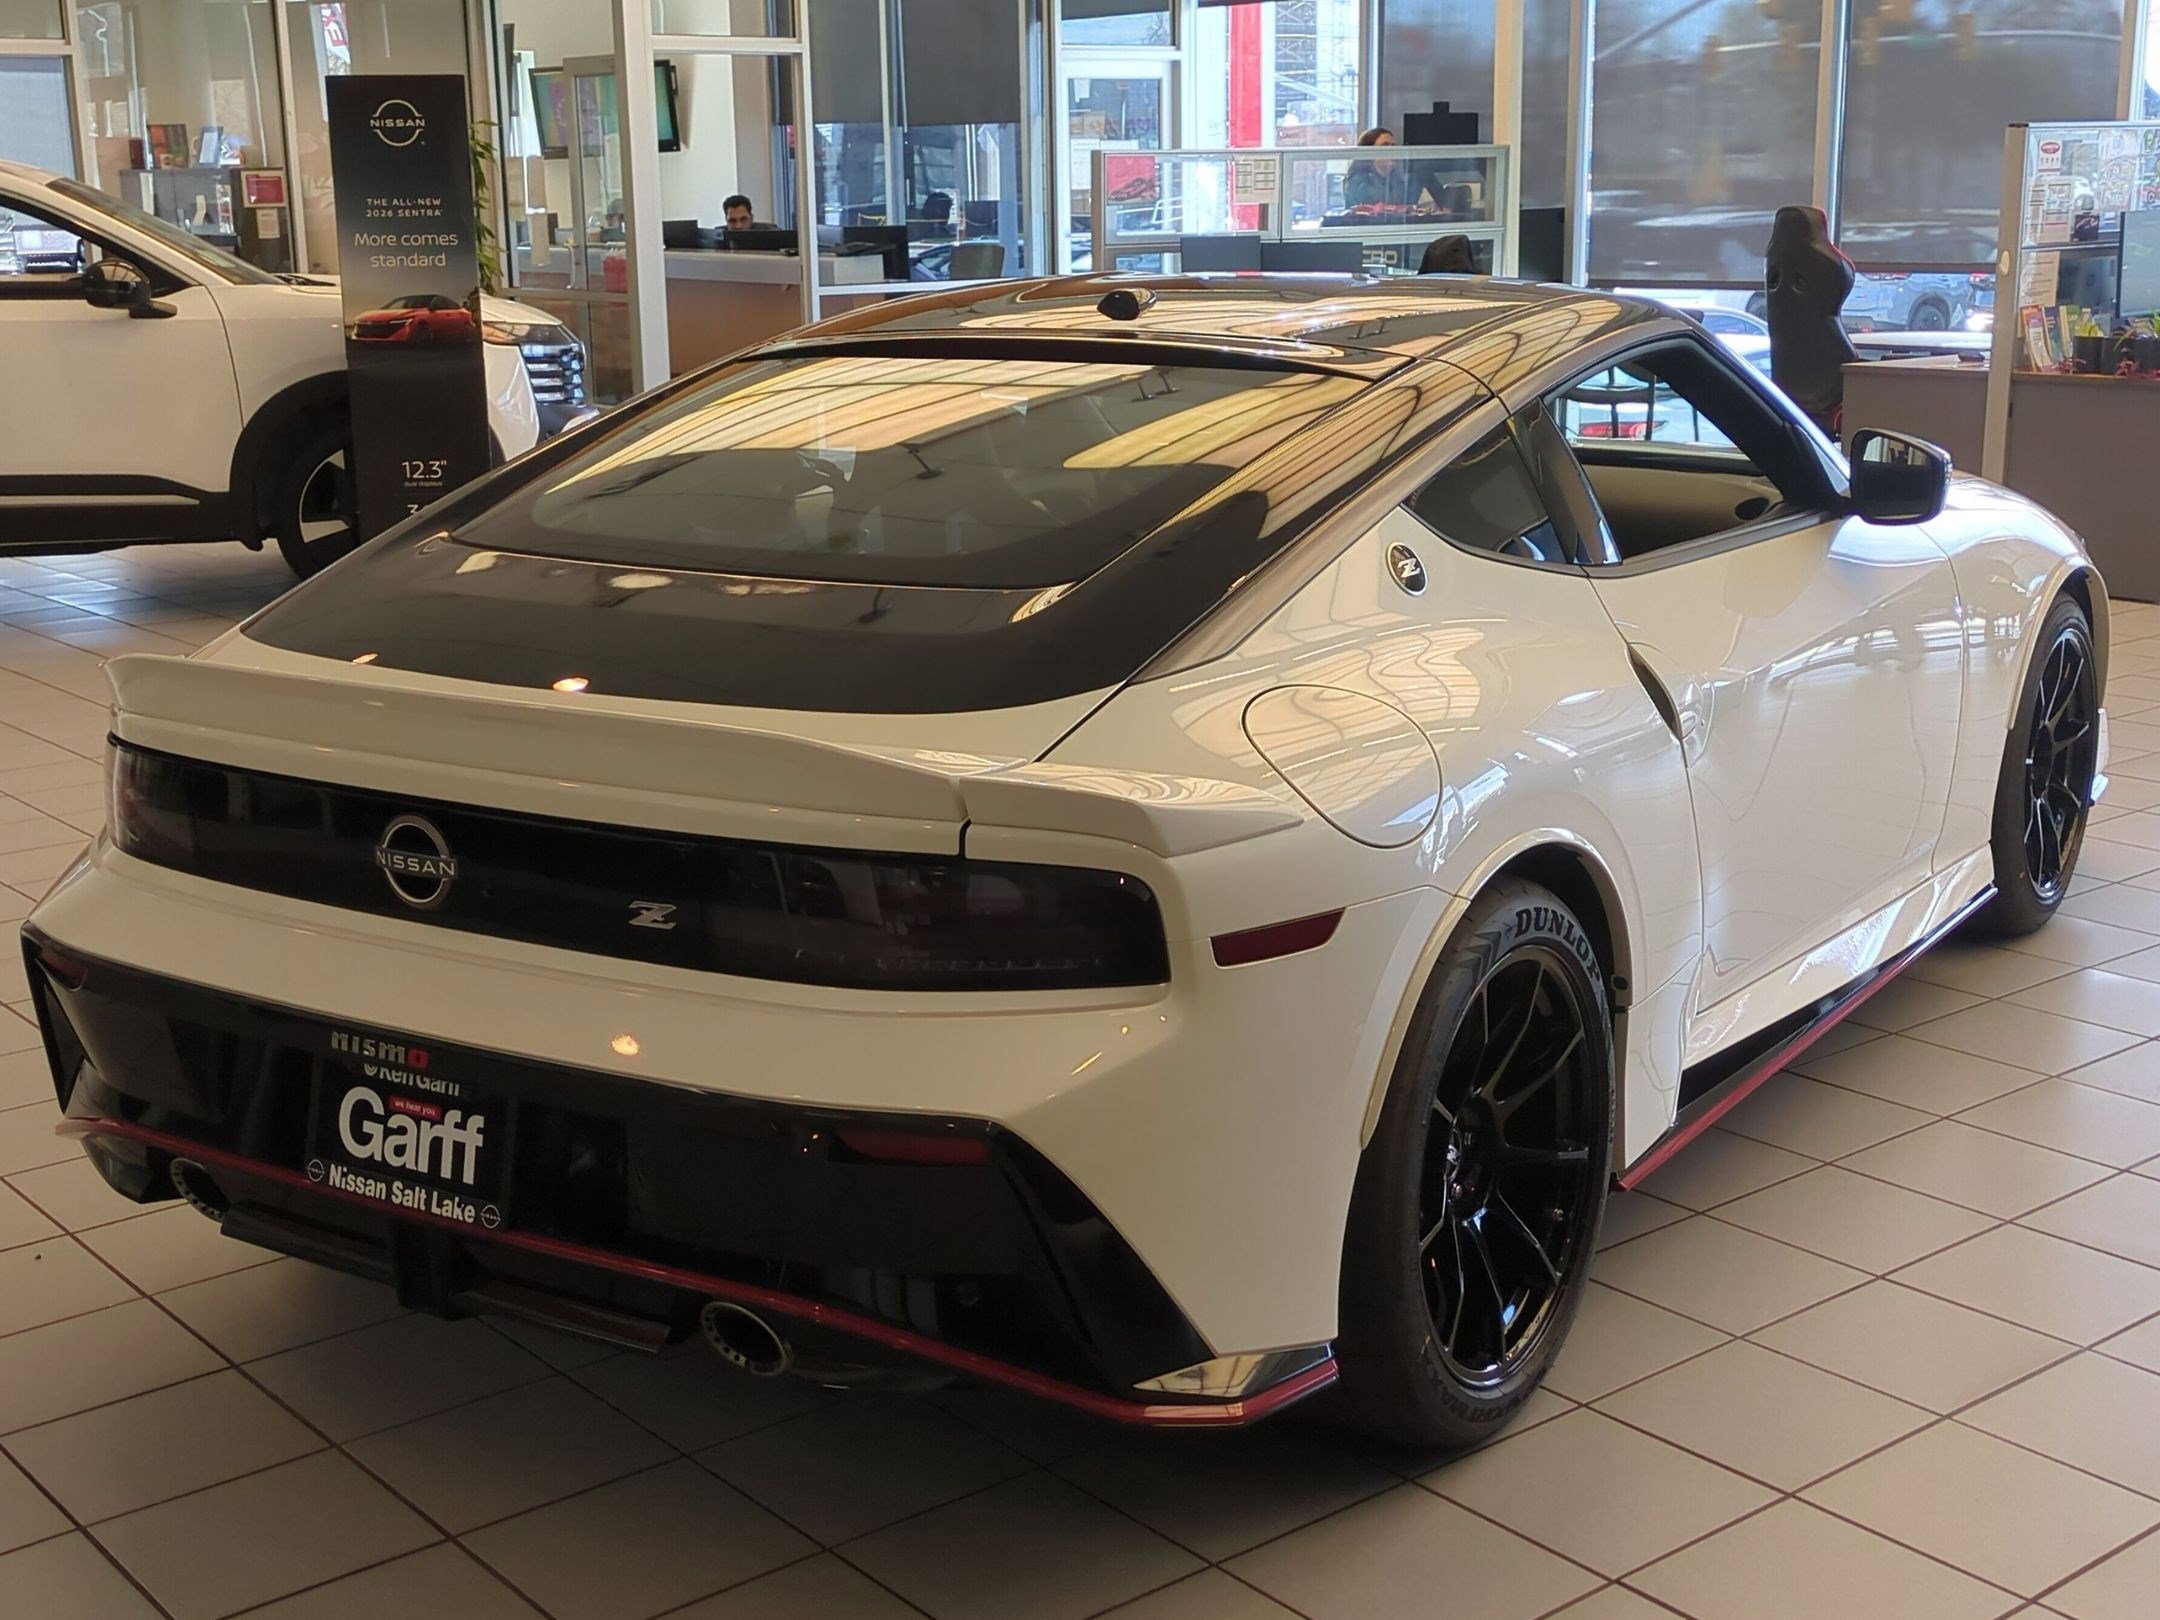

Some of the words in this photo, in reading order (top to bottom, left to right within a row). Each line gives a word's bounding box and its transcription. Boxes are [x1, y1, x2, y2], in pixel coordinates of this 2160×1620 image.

[370, 118, 425, 127] NISSAN
[367, 198, 388, 206] THE
[392, 198, 441, 206] ALL-NEW
[366, 209, 393, 217] 2026
[354, 232, 397, 246] More
[400, 233, 458, 246] comes
[370, 252, 446, 268] standard
[401, 460, 447, 479] 12.3"
[375, 849, 456, 877] NISSAN
[628, 900, 677, 930] Z
[1514, 906, 1601, 982] DUNLOP
[394, 1100, 405, 1109] we
[406, 1100, 422, 1112] hear
[422, 1106, 436, 1116] you
[338, 1086, 485, 1185] Garff
[328, 1163, 388, 1200] Nissan
[391, 1180, 427, 1212] Salt
[431, 1191, 476, 1224] Lake
